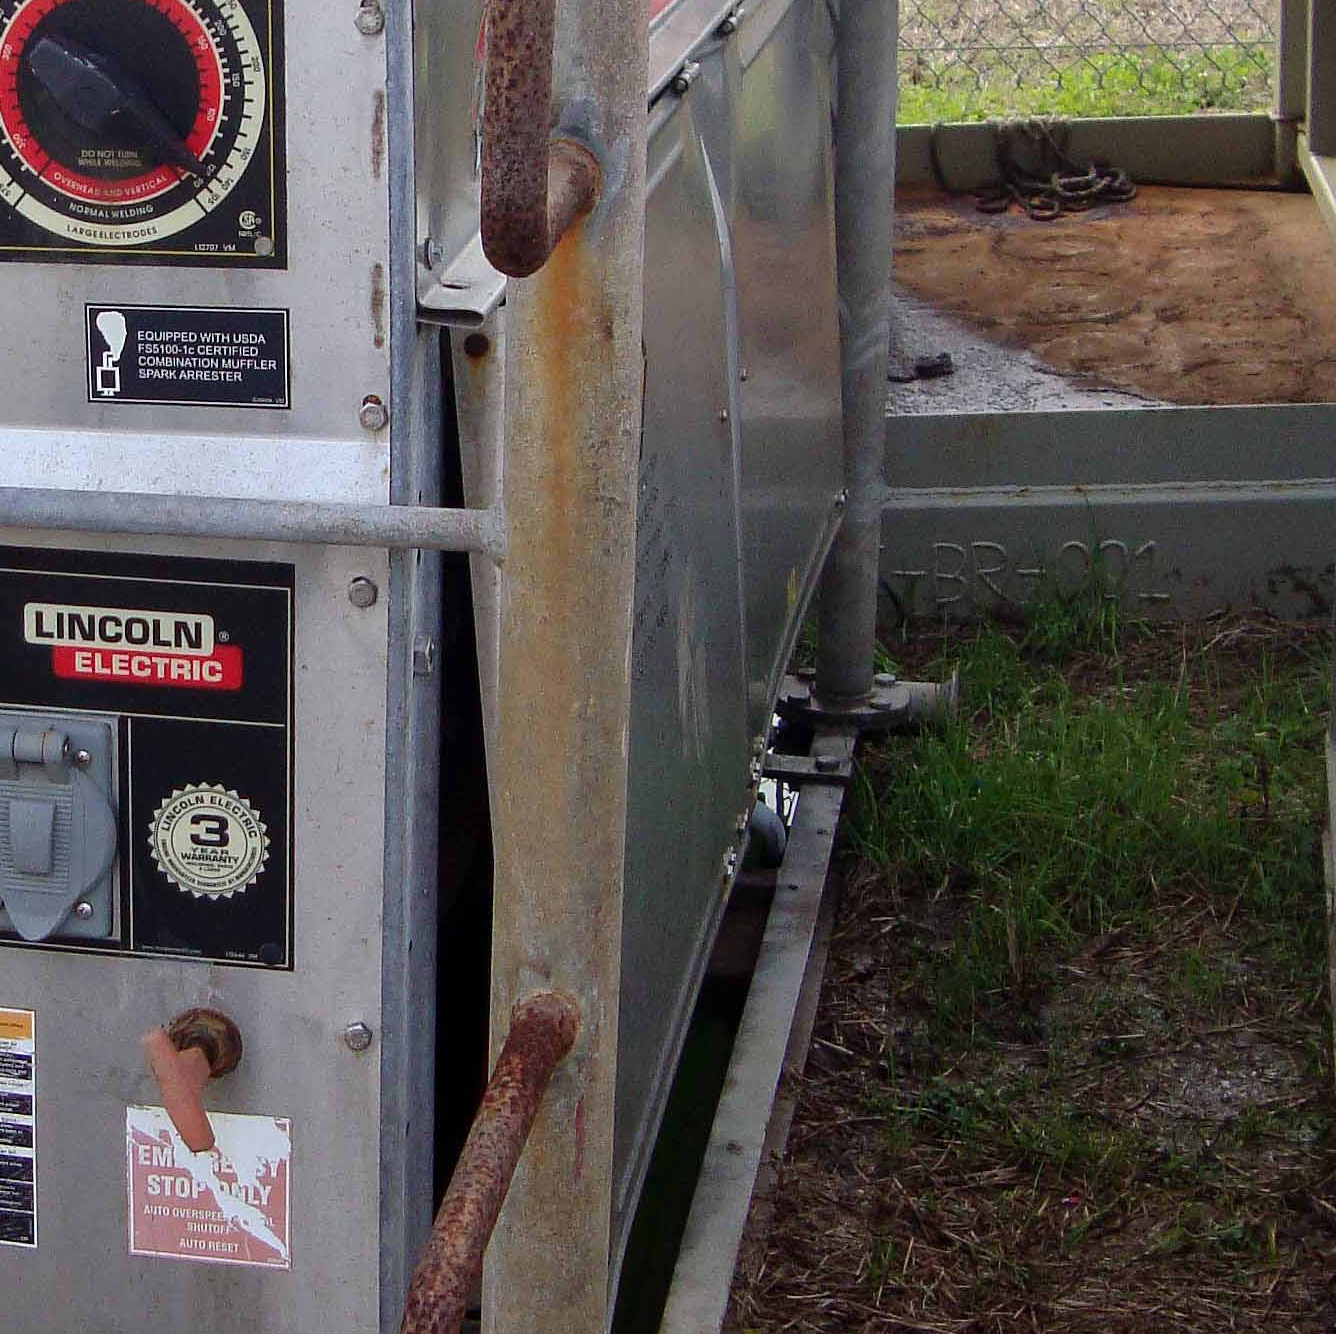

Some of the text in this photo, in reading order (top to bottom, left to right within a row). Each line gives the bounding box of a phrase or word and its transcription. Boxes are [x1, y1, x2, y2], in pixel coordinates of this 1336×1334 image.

[81, 149, 96, 158] DO
[97, 150, 115, 158] NOT
[53, 171, 101, 196] OVERHEAD
[124, 174, 168, 196] VERTICAL
[68, 202, 154, 219] NORMAL WELDING
[66, 224, 158, 240] LARGE ELECTRODES
[137, 330, 266, 345] EQUIPPED WITH USDA
[137, 343, 259, 357] FS5100-1c CERTIFIED
[137, 355, 277, 370] COMBINATION MUFFLER
[138, 368, 243, 382] SPARK ARRESTER
[35, 610, 203, 649] LINCOLN
[74, 650, 223, 683] ELECTRIC
[160, 794, 259, 839] LINCOLN ELECTRIC
[189, 813, 230, 848] 3
[180, 852, 240, 865] WARRANTY
[191, 847, 230, 855] YEAR
[143, 1204, 225, 1220] AUTO OVERSPEE
[179, 1237, 240, 1254] AUTO RESET
